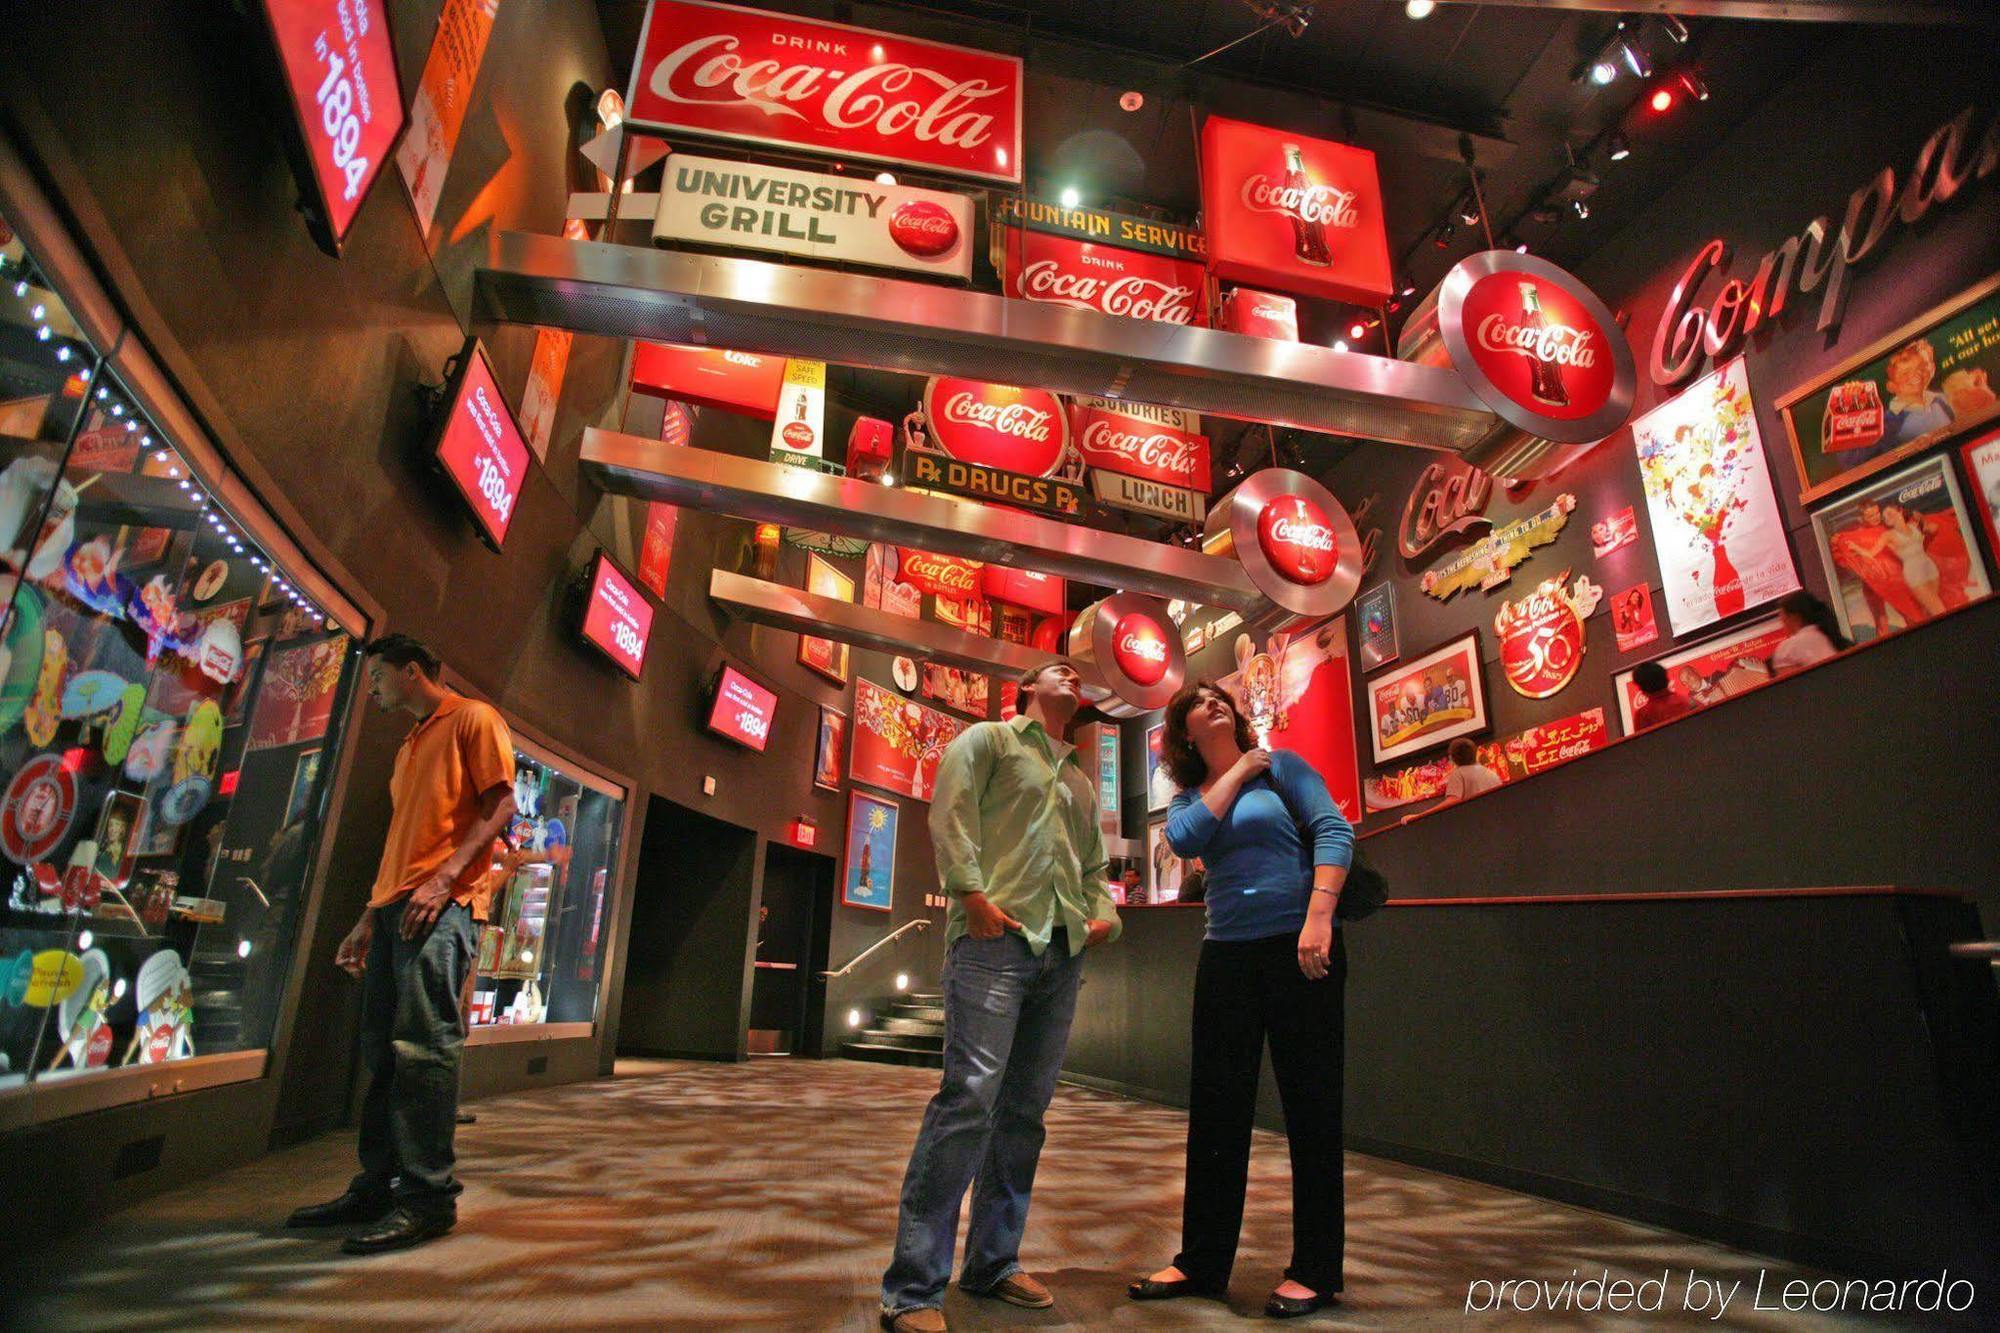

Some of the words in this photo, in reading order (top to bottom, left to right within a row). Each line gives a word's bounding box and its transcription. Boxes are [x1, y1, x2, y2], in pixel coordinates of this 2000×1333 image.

[314, 30, 328, 62] in
[771, 33, 848, 56] DRINK
[353, 61, 371, 123] bottles
[648, 34, 1007, 149] Coca-Cola
[316, 51, 368, 200] 1894
[675, 168, 887, 220] UNIVERSITY
[1241, 173, 1359, 229] Coca-Cola
[701, 204, 836, 245] GRILL
[895, 213, 953, 234] Coca-Cola
[1001, 197, 1110, 235] FOUNTAIN
[1121, 220, 1207, 254] SERVICE
[1082, 255, 1124, 271] DRINK
[1017, 260, 1193, 325] Coca-Cola
[1477, 312, 1595, 369] Coca-Cola
[944, 391, 1052, 443] Coca-Cola
[783, 453, 808, 465] DRIVE
[1082, 421, 1200, 474] Coca-Cola
[477, 456, 513, 522] 1894
[949, 464, 1049, 505] DRUGS
[1121, 480, 1187, 513] LUNCH
[1271, 517, 1334, 551] Coca-Cola
[904, 555, 975, 590] Coca-Cola
[615, 620, 644, 661] 1894
[1526, 627, 1571, 672] 50
[737, 709, 767, 740] 1894
